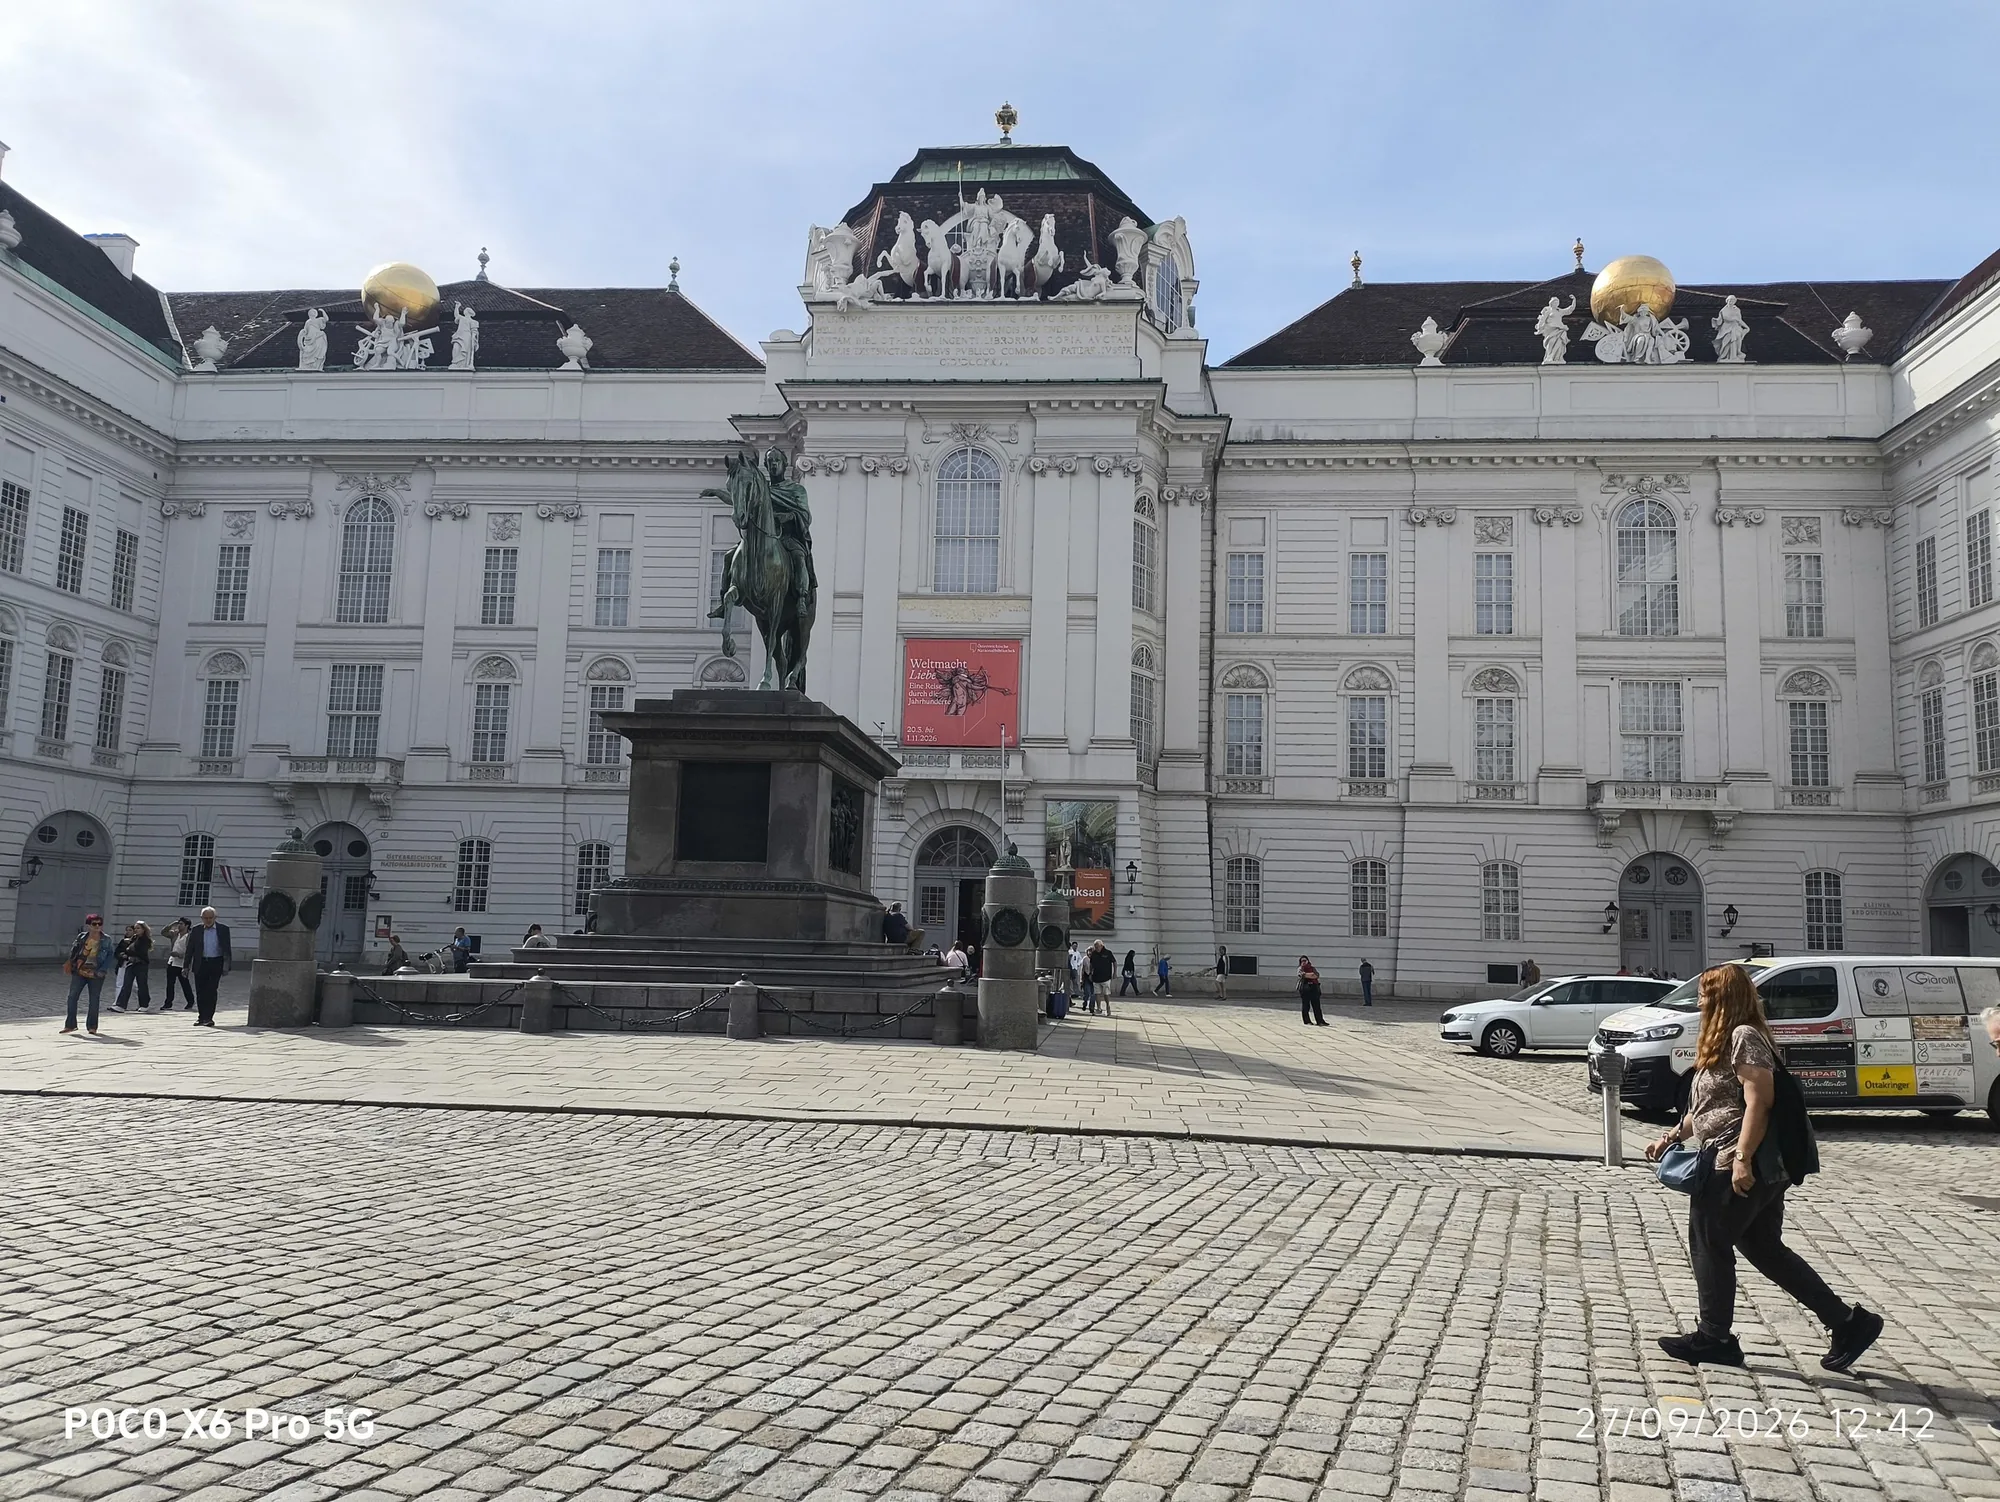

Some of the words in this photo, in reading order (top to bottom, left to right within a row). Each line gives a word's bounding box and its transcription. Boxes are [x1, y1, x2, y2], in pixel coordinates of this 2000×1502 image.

[910, 659, 967, 669] Weltmacht
[909, 669, 936, 680] Liebe
[909, 682, 925, 690] Eine
[925, 682, 943, 690] Reise
[1915, 971, 1957, 985] Giarolli
[1864, 1080, 1910, 1091] Ottakringer
